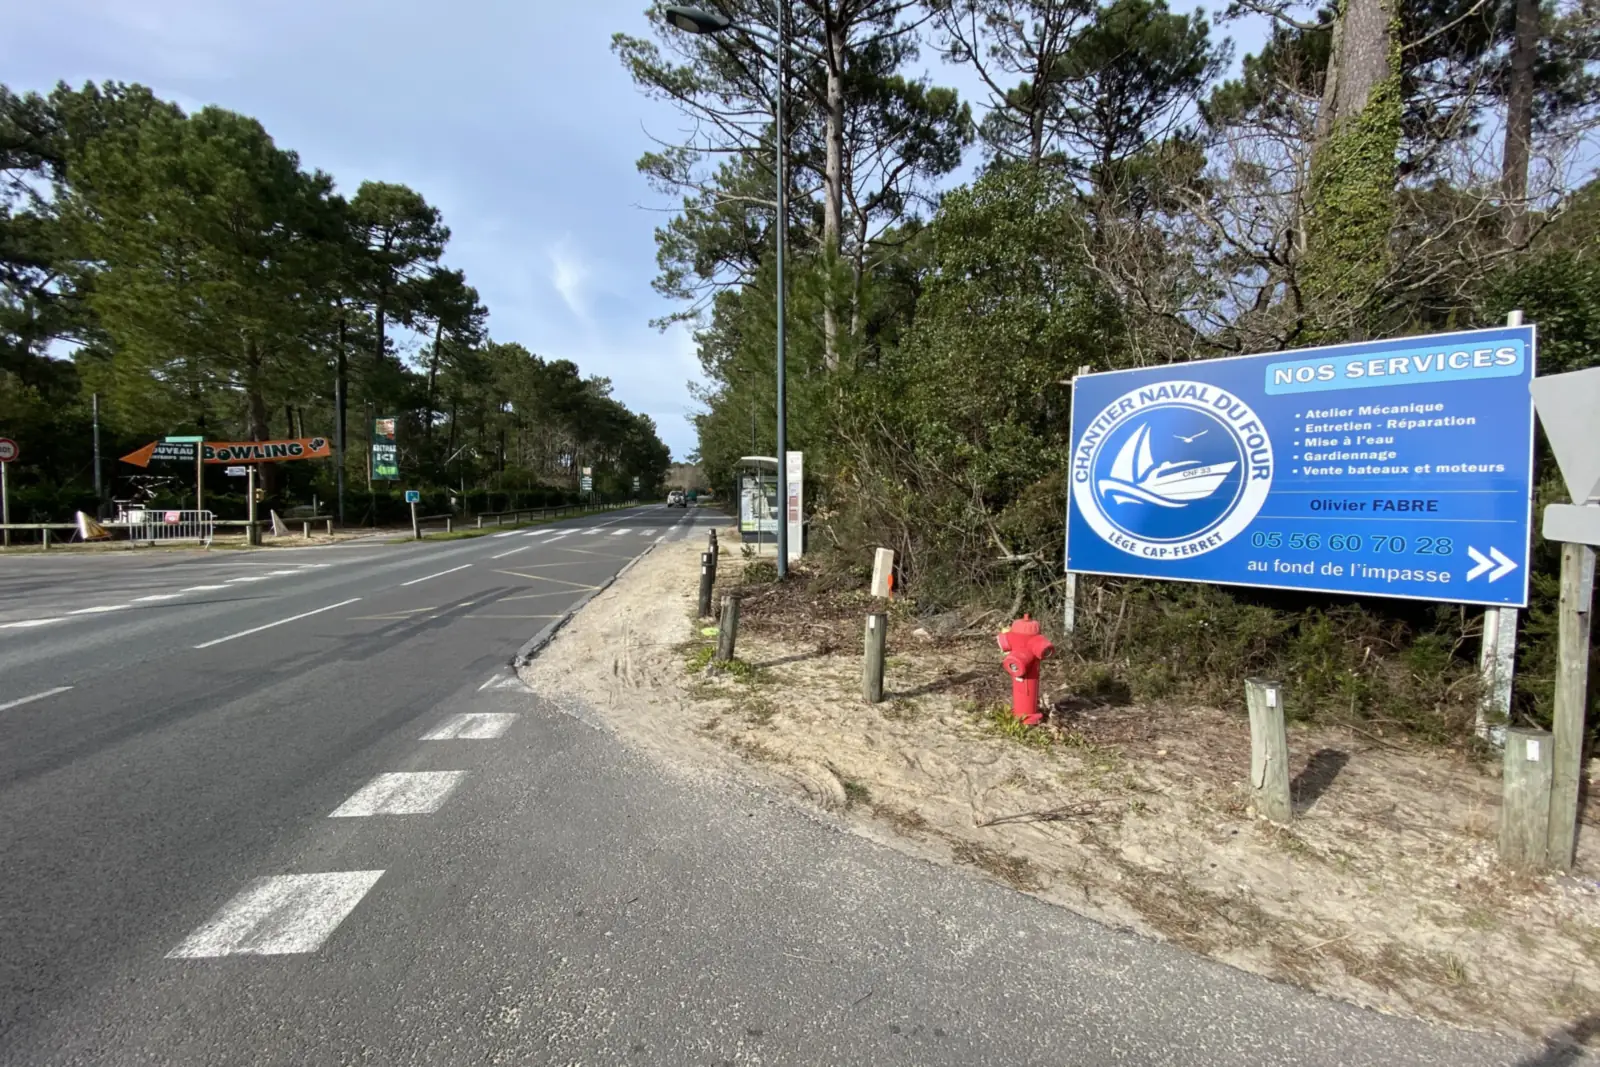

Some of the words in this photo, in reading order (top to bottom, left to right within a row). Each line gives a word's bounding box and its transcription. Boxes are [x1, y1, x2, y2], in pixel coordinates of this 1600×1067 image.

[1274, 364, 1336, 385] NOS
[1344, 347, 1518, 379] SERVICES
[1305, 408, 1353, 419] Atelier
[1358, 402, 1445, 415] Mécanique
[1305, 421, 1372, 433] Entretien
[1387, 415, 1476, 430] Réparation
[1075, 397, 1134, 483] CHANTIER
[1138, 384, 1211, 405] NAVAL
[1212, 393, 1248, 421] DU
[1239, 420, 1270, 481] FOUR
[1304, 437, 1338, 447] Mise
[1343, 436, 1351, 446] à
[1357, 435, 1394, 445] l'eau
[1303, 449, 1397, 462] Gardiennage
[1182, 469, 1199, 478] CNF
[1303, 465, 1343, 476] Vente
[1348, 464, 1409, 476] bateaux
[1414, 464, 1430, 474] et
[1436, 462, 1505, 473] moteurs
[1310, 499, 1366, 511] Olivier
[1372, 499, 1439, 513] FABRE
[1108, 531, 1137, 552] LÈGE
[1142, 532, 1224, 557] CAP-FERRET
[1251, 531, 1282, 549] 05
[1288, 532, 1321, 550] 56
[1327, 534, 1363, 552] 60
[1370, 535, 1407, 554] 70
[1414, 536, 1453, 557] 28
[1247, 560, 1268, 572] au
[1274, 559, 1315, 575] fond
[1320, 562, 1344, 577] de
[1350, 563, 1451, 583] l'impasse
